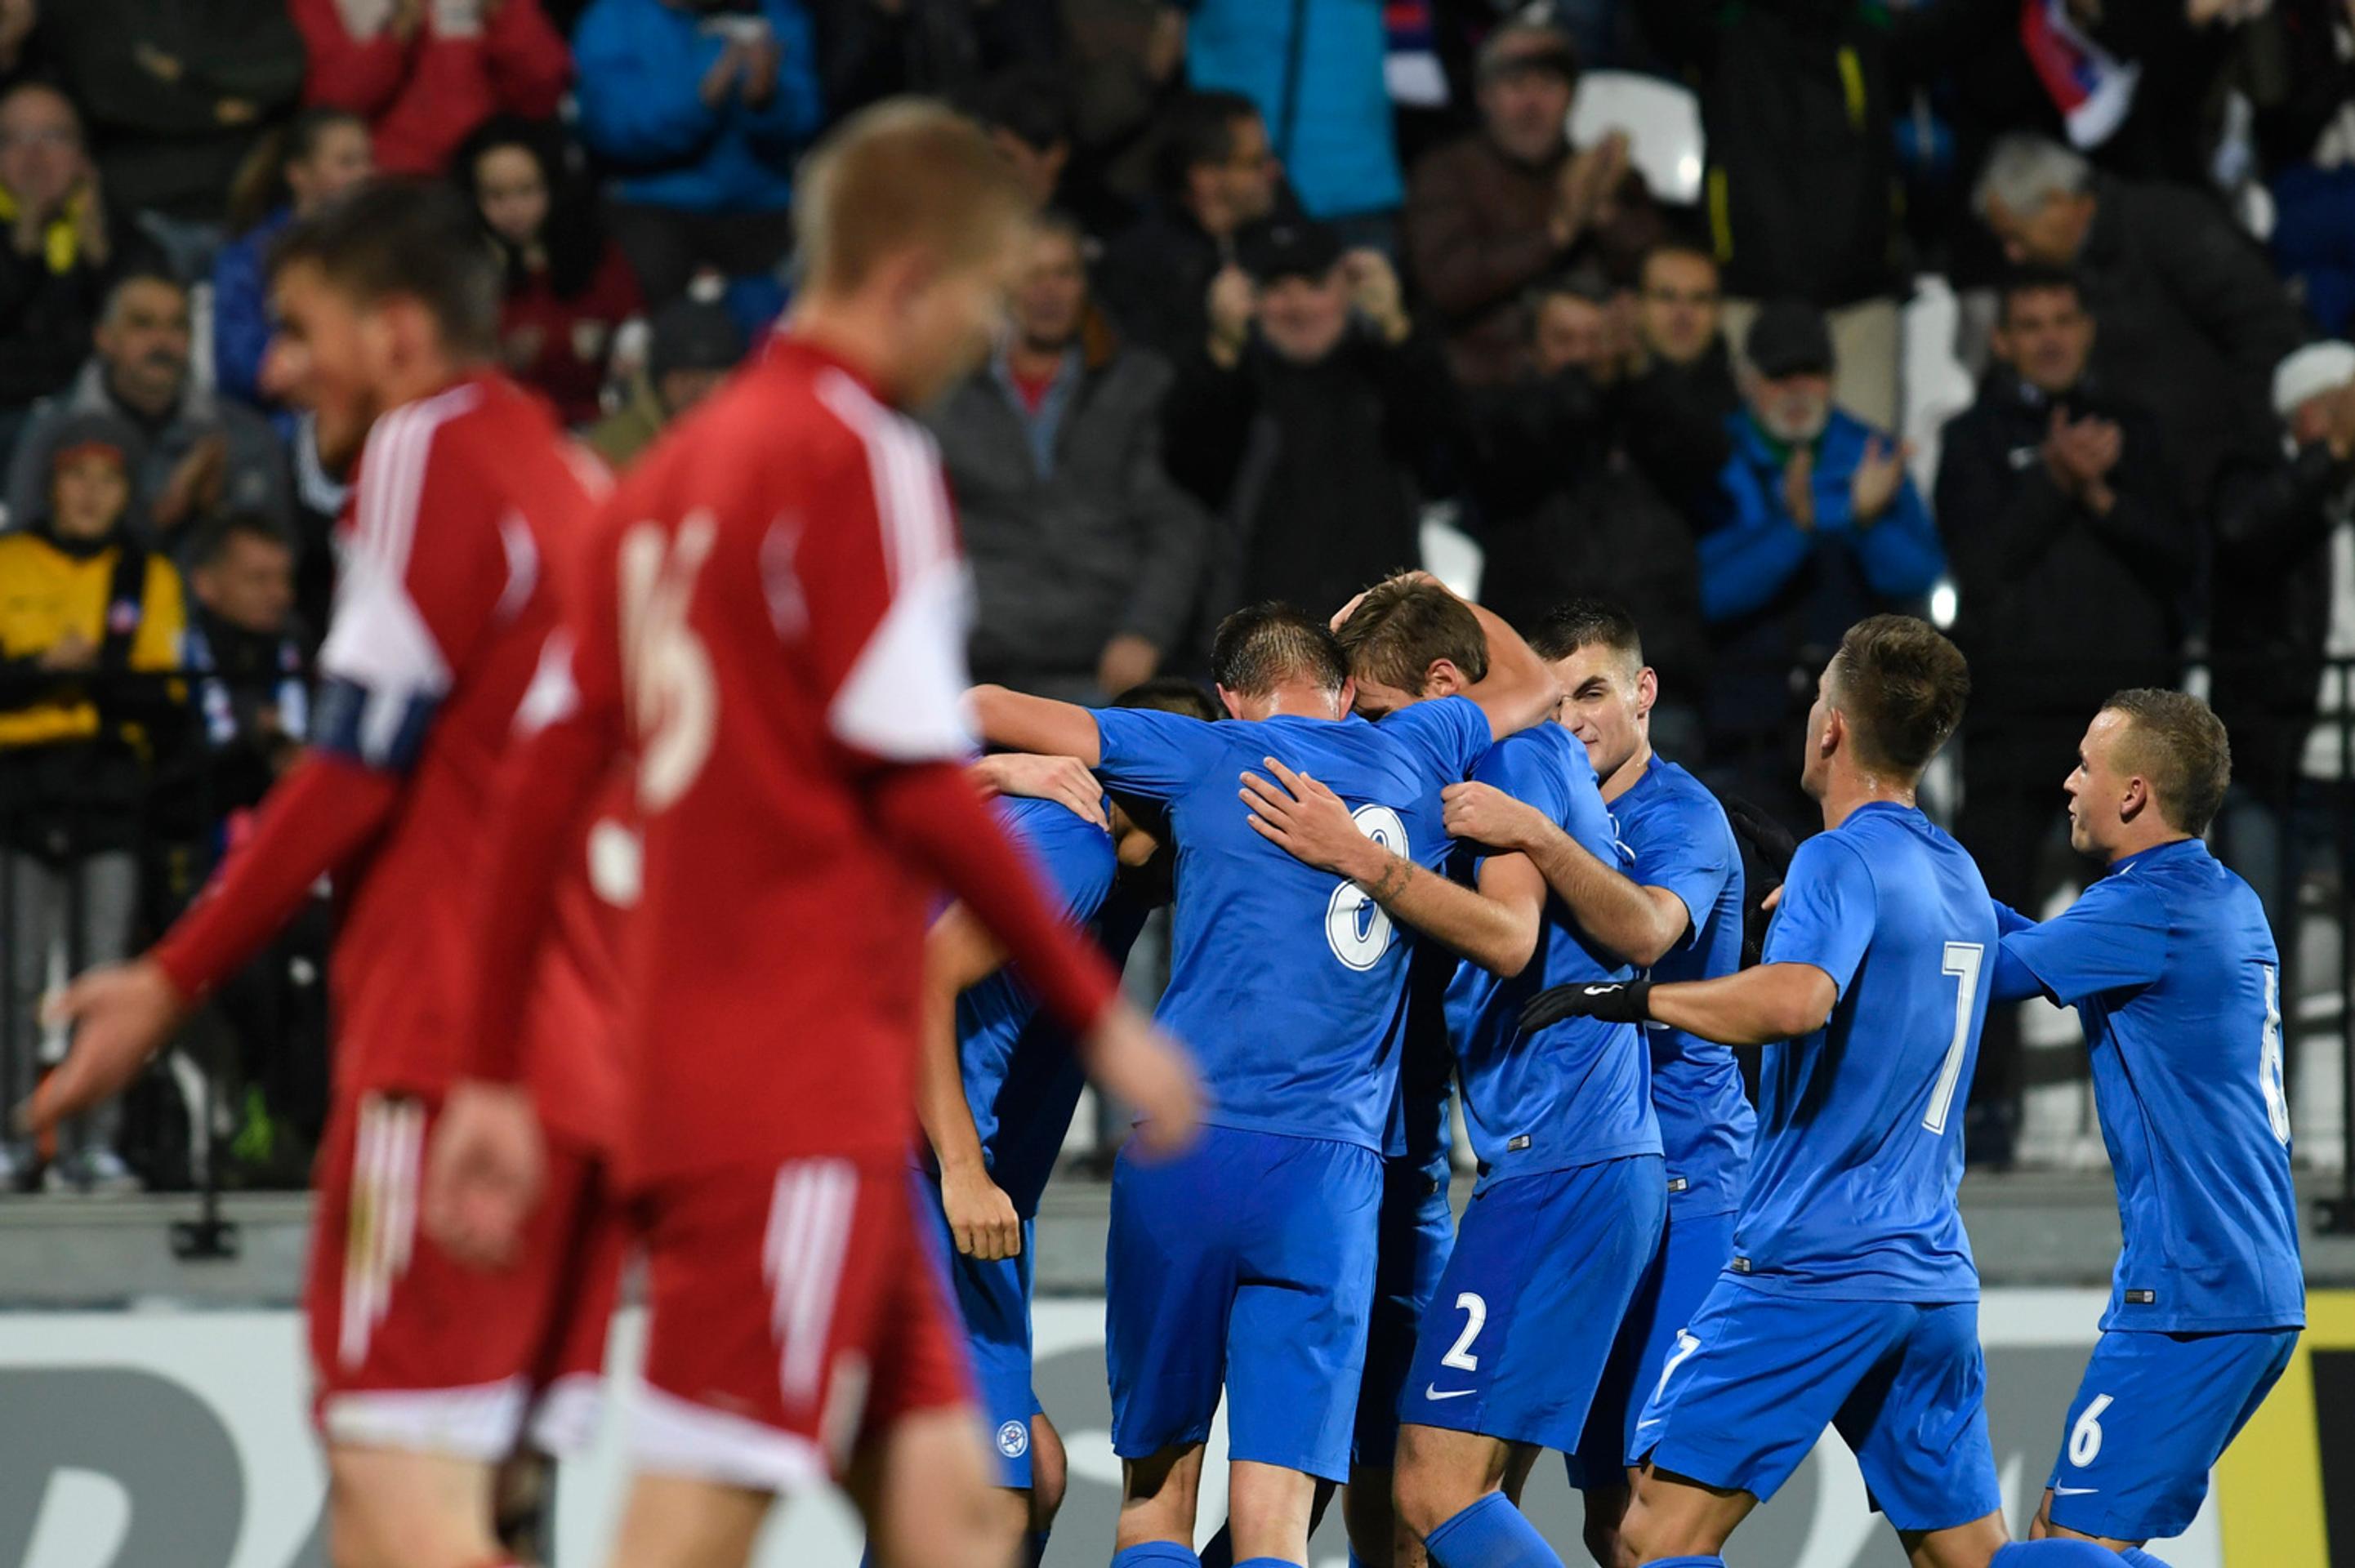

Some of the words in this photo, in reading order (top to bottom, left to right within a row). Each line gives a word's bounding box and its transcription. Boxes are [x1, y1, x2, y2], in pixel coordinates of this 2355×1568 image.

[1921, 941, 1985, 1136] 7
[1441, 1292, 1487, 1372] 2
[1654, 1328, 1702, 1405] 7
[2068, 1393, 2114, 1468] 6
